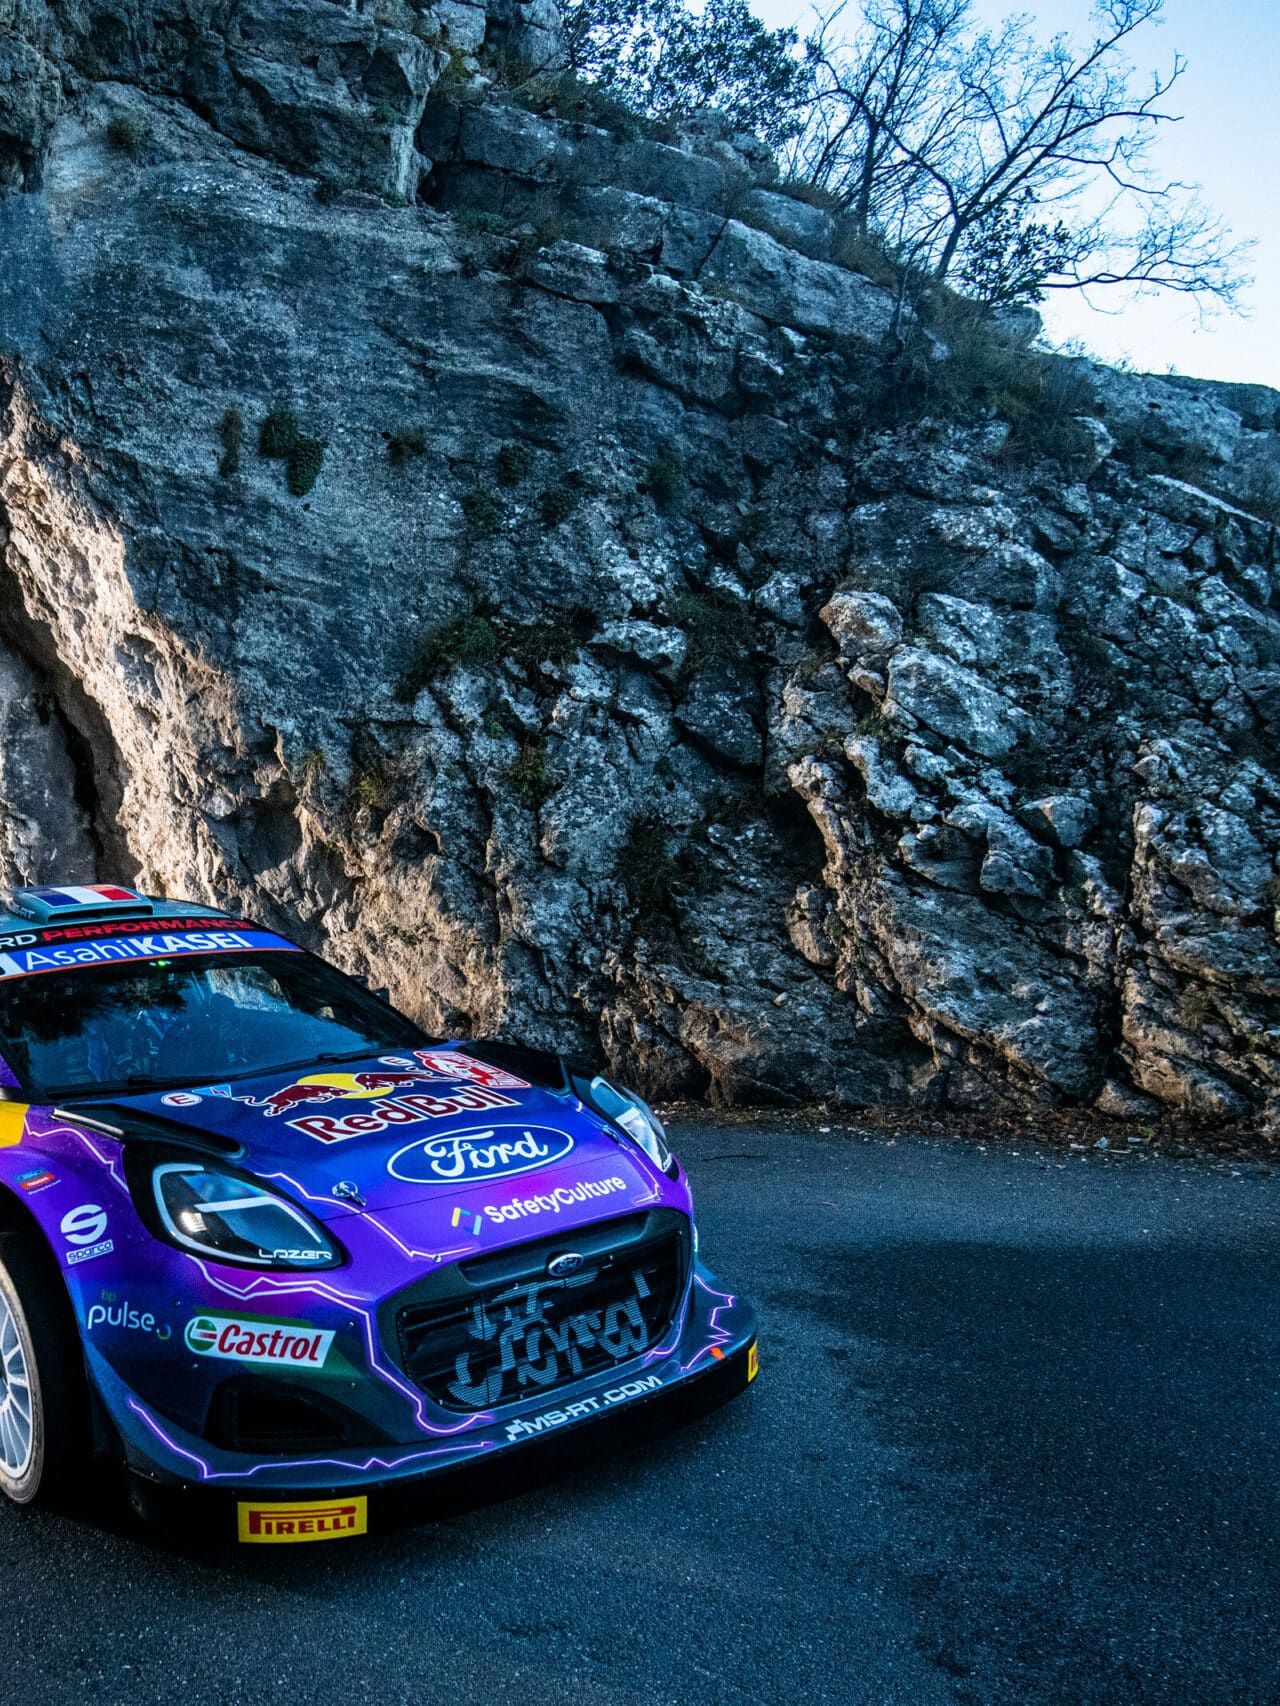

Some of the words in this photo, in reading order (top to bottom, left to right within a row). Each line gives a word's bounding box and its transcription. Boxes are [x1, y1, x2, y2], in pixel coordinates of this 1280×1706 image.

[43, 918, 254, 942] PERFORMANCE
[288, 1099, 426, 1143] Red
[395, 1086, 520, 1118] Bull
[423, 1129, 549, 1177] Ford
[483, 1173, 627, 1224] SafetyCulture
[68, 1241, 113, 1261] sparco
[87, 1301, 156, 1332] pulse
[217, 1323, 323, 1362] Castrol
[248, 1505, 357, 1535] PIRELLI
